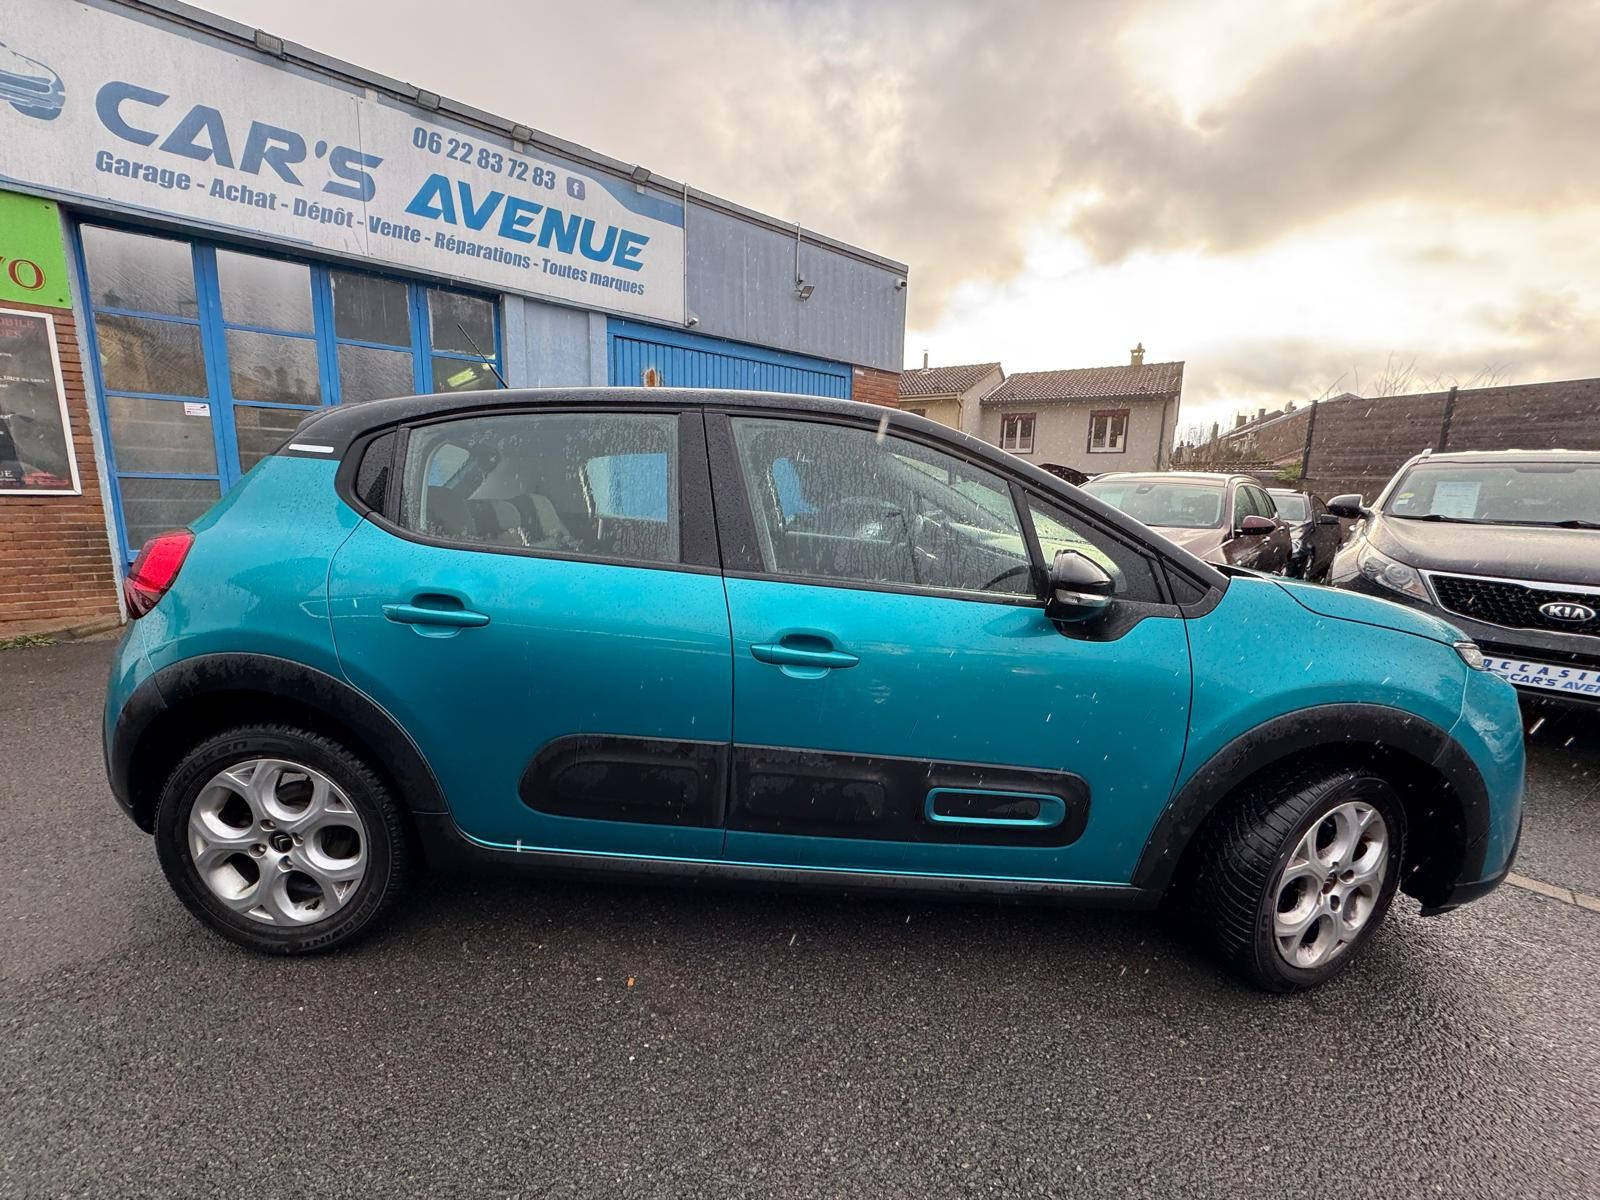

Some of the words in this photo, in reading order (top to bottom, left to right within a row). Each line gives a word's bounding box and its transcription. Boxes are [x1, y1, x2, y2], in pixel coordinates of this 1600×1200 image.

[95, 80, 385, 203] CAR'S
[404, 172, 651, 272] AVENUE
[412, 127, 443, 154] 06
[446, 138, 474, 165] 22
[477, 148, 503, 174] 83
[507, 158, 529, 182] 72
[532, 167, 557, 190] 83
[95, 150, 191, 190] Garage
[209, 178, 277, 211] Achat
[292, 197, 353, 228] Dépôt
[368, 215, 421, 244] Vente
[434, 231, 531, 269] Réparations
[541, 258, 588, 283] Toutes
[589, 273, 645, 296] marques
[0, 256, 47, 291] O
[1548, 605, 1586, 619] KIA
[1482, 658, 1600, 682] OCCASI
[1510, 673, 1558, 687] CAR'S
